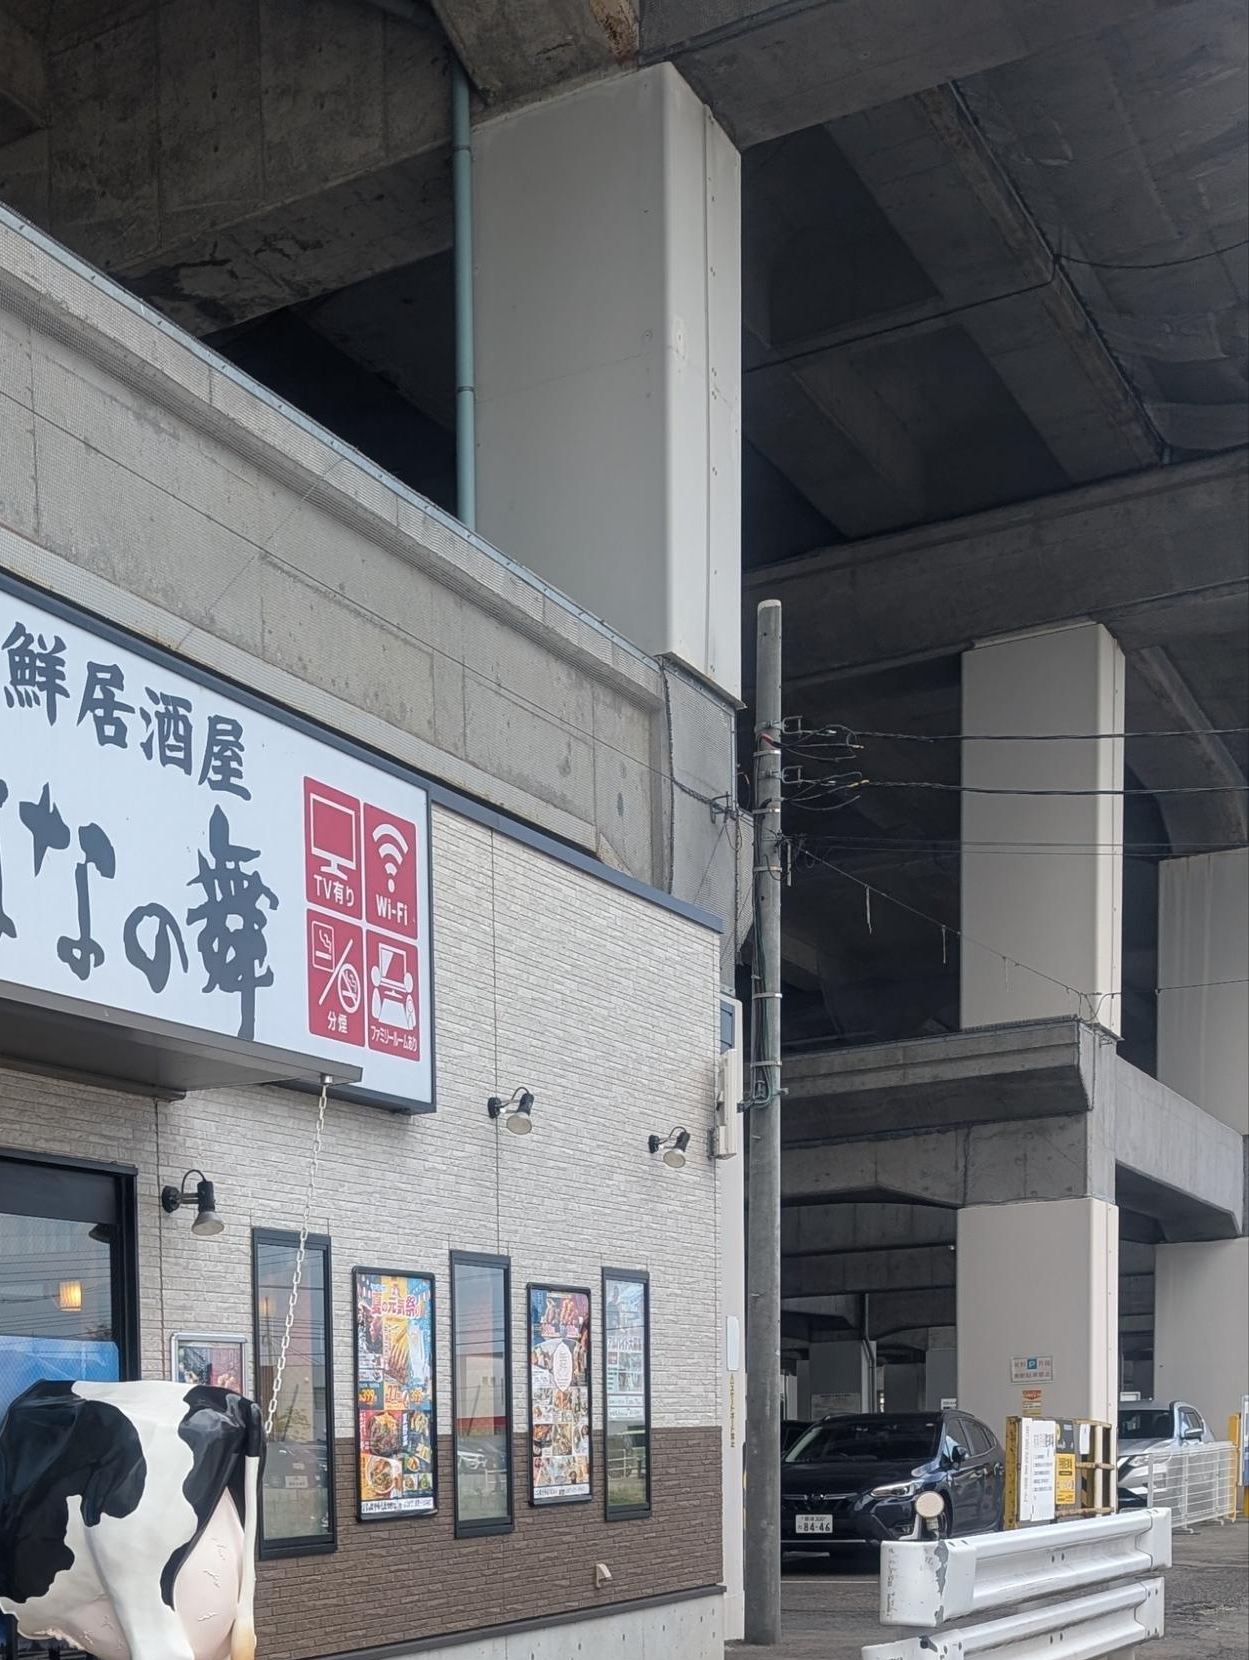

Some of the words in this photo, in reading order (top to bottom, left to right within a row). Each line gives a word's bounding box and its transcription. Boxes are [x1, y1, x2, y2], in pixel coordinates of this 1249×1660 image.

[314, 875, 355, 907] TV有り
[376, 895, 409, 926] Wi-Fi
[327, 1012, 349, 1034] 分煙
[370, 1025, 418, 1052] ファミリールームあり
